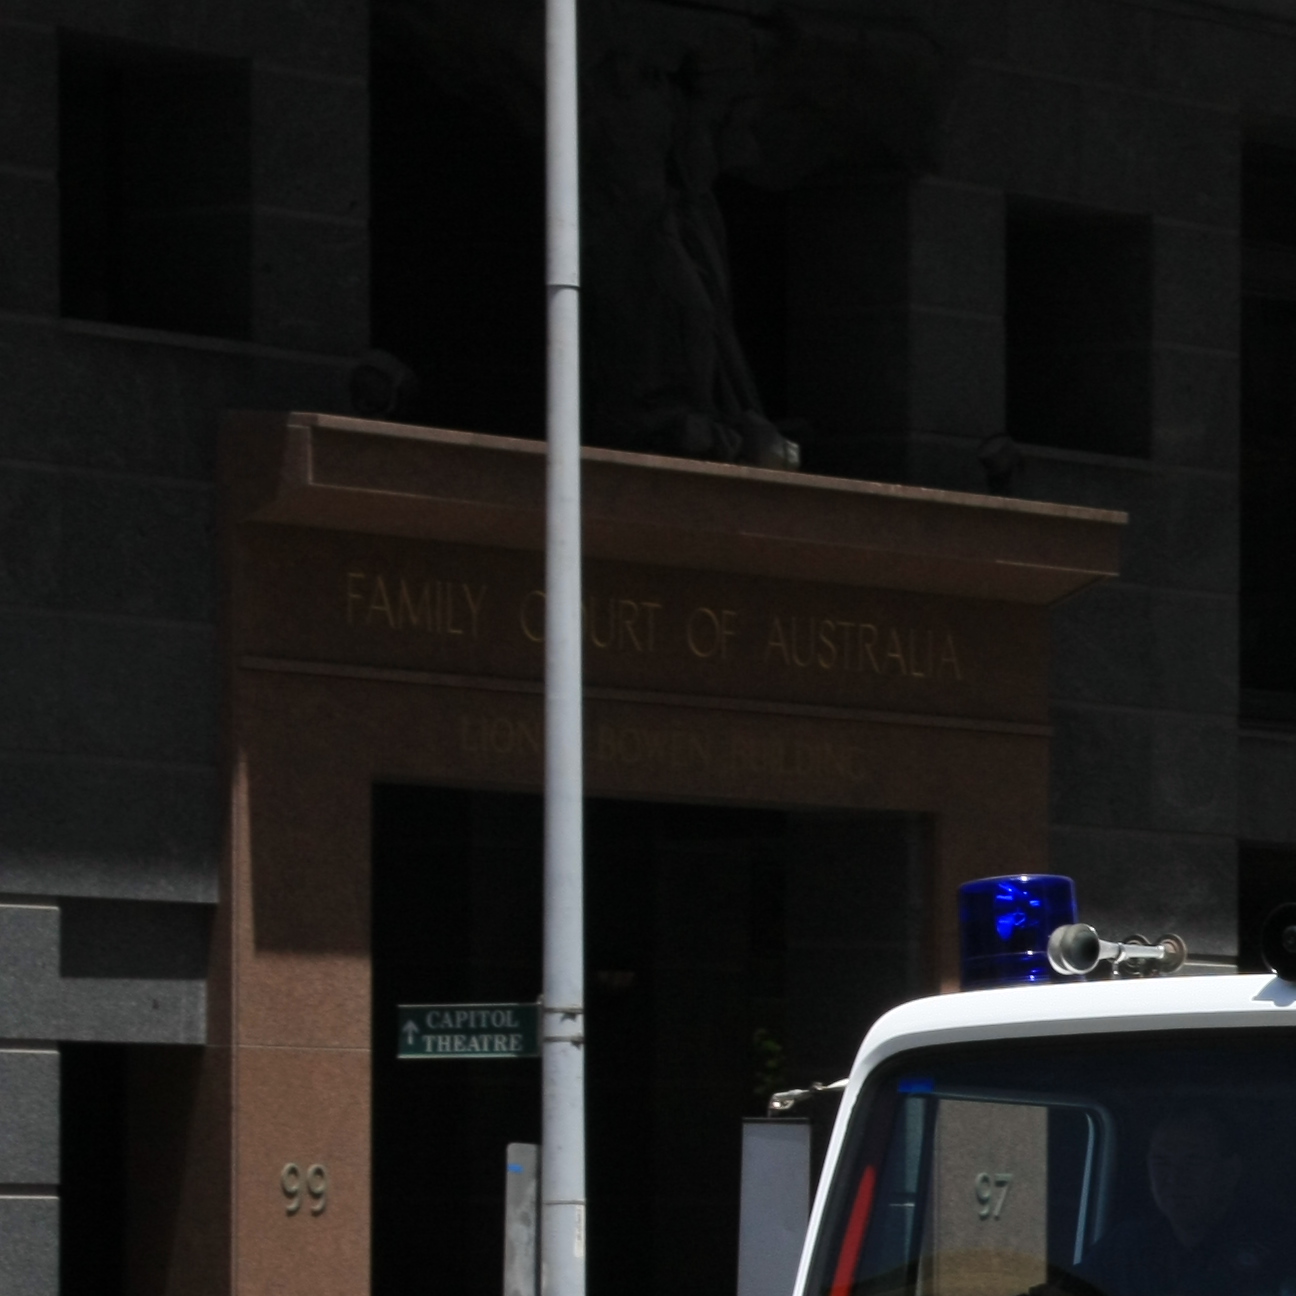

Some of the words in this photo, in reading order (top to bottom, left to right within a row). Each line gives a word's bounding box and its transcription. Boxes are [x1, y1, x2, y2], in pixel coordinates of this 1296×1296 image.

[346, 571, 488, 638] FAMILY
[519, 589, 663, 653] CURT
[686, 606, 738, 660] OF
[763, 616, 964, 681] AUSTRALIA
[421, 1033, 524, 1054] THEATRE
[425, 1009, 520, 1030] CAPITOL
[280, 1162, 328, 1216] 99
[975, 1171, 1013, 1221] 97
